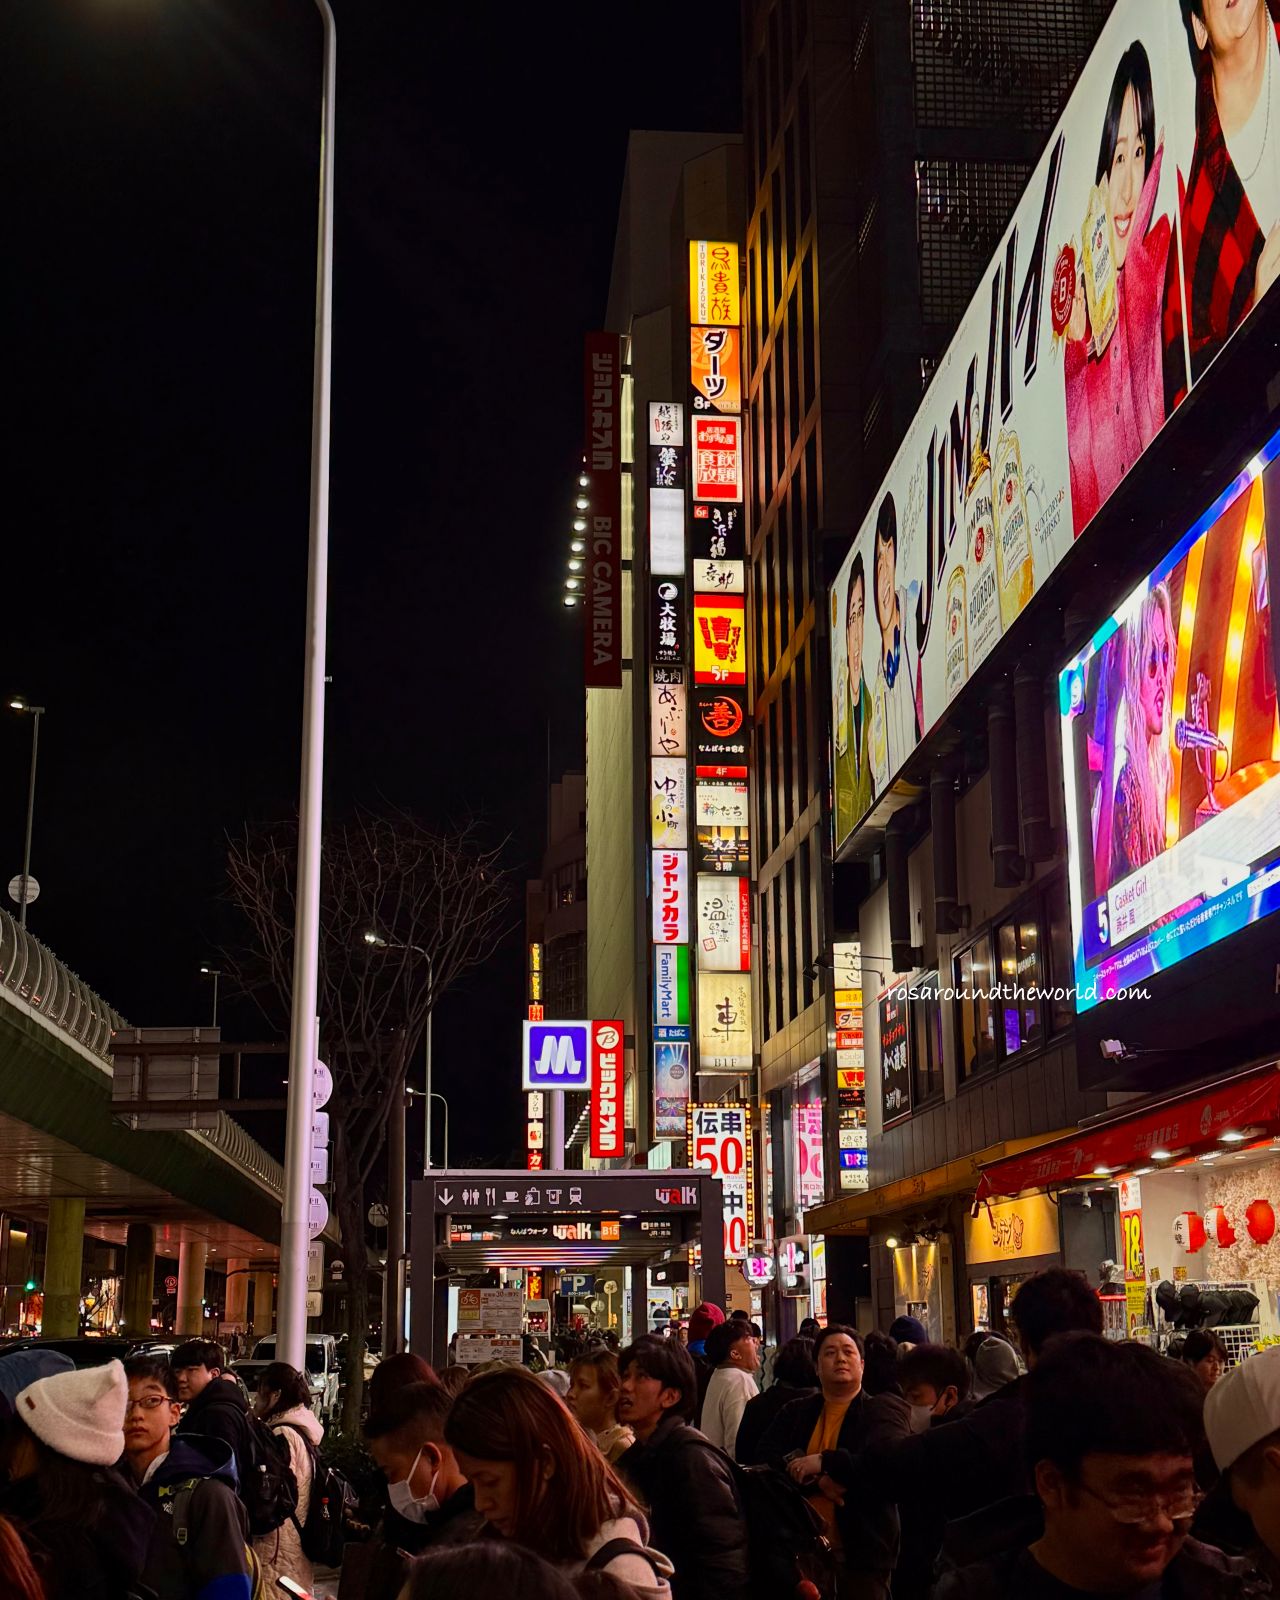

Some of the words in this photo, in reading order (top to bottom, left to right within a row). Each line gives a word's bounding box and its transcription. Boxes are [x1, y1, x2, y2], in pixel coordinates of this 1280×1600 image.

[703, 328, 729, 400] ダーツ
[592, 352, 613, 470] ビックカメラ
[693, 396, 711, 410] 8F
[696, 506, 709, 518] 6F
[593, 516, 613, 555] BIC
[969, 571, 996, 626] BOURBON
[593, 563, 613, 666] CAMERA
[659, 601, 677, 648] 大牧場
[655, 669, 682, 684] 焼肉
[710, 665, 729, 681] 5F
[715, 767, 728, 776] 4F
[714, 861, 733, 872] 3階
[662, 853, 680, 941] ジャンカラ
[1115, 884, 1135, 911] Casket
[1135, 876, 1148, 900] Girl
[1097, 901, 1108, 944] 5
[661, 952, 672, 1019] FamilyMart
[714, 1058, 738, 1068] B1F
[599, 1052, 617, 1152] ビックカメラ
[695, 1110, 743, 1136] 伝串
[655, 1185, 697, 1206] walk
[723, 1183, 745, 1191] ラベル
[510, 1227, 548, 1237] なんばウォーク
[552, 1222, 592, 1241] walk
[601, 1225, 619, 1236] B15
[572, 1276, 586, 1292] P
